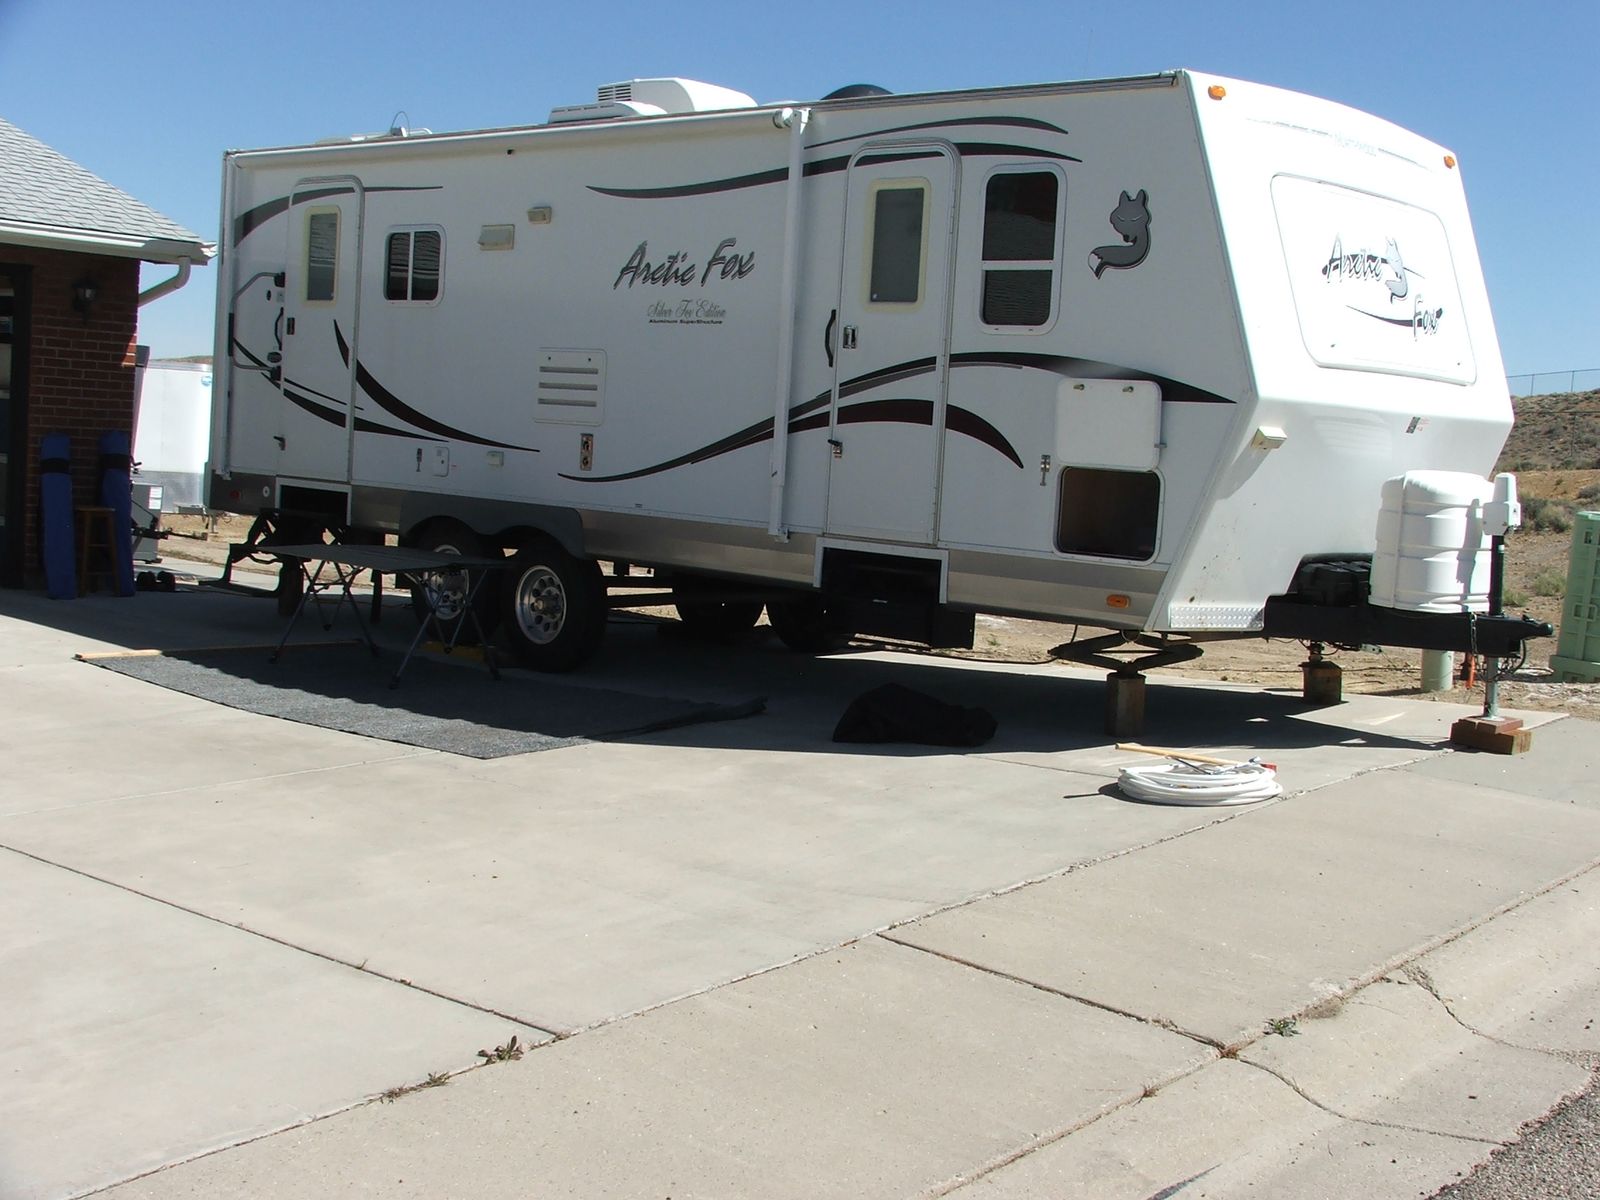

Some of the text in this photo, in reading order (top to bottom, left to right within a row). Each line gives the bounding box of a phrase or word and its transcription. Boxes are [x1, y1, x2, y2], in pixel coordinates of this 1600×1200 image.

[613, 237, 755, 290] Arctic Fox
[1327, 233, 1383, 284] Arctic
[1412, 294, 1438, 342] Fox
